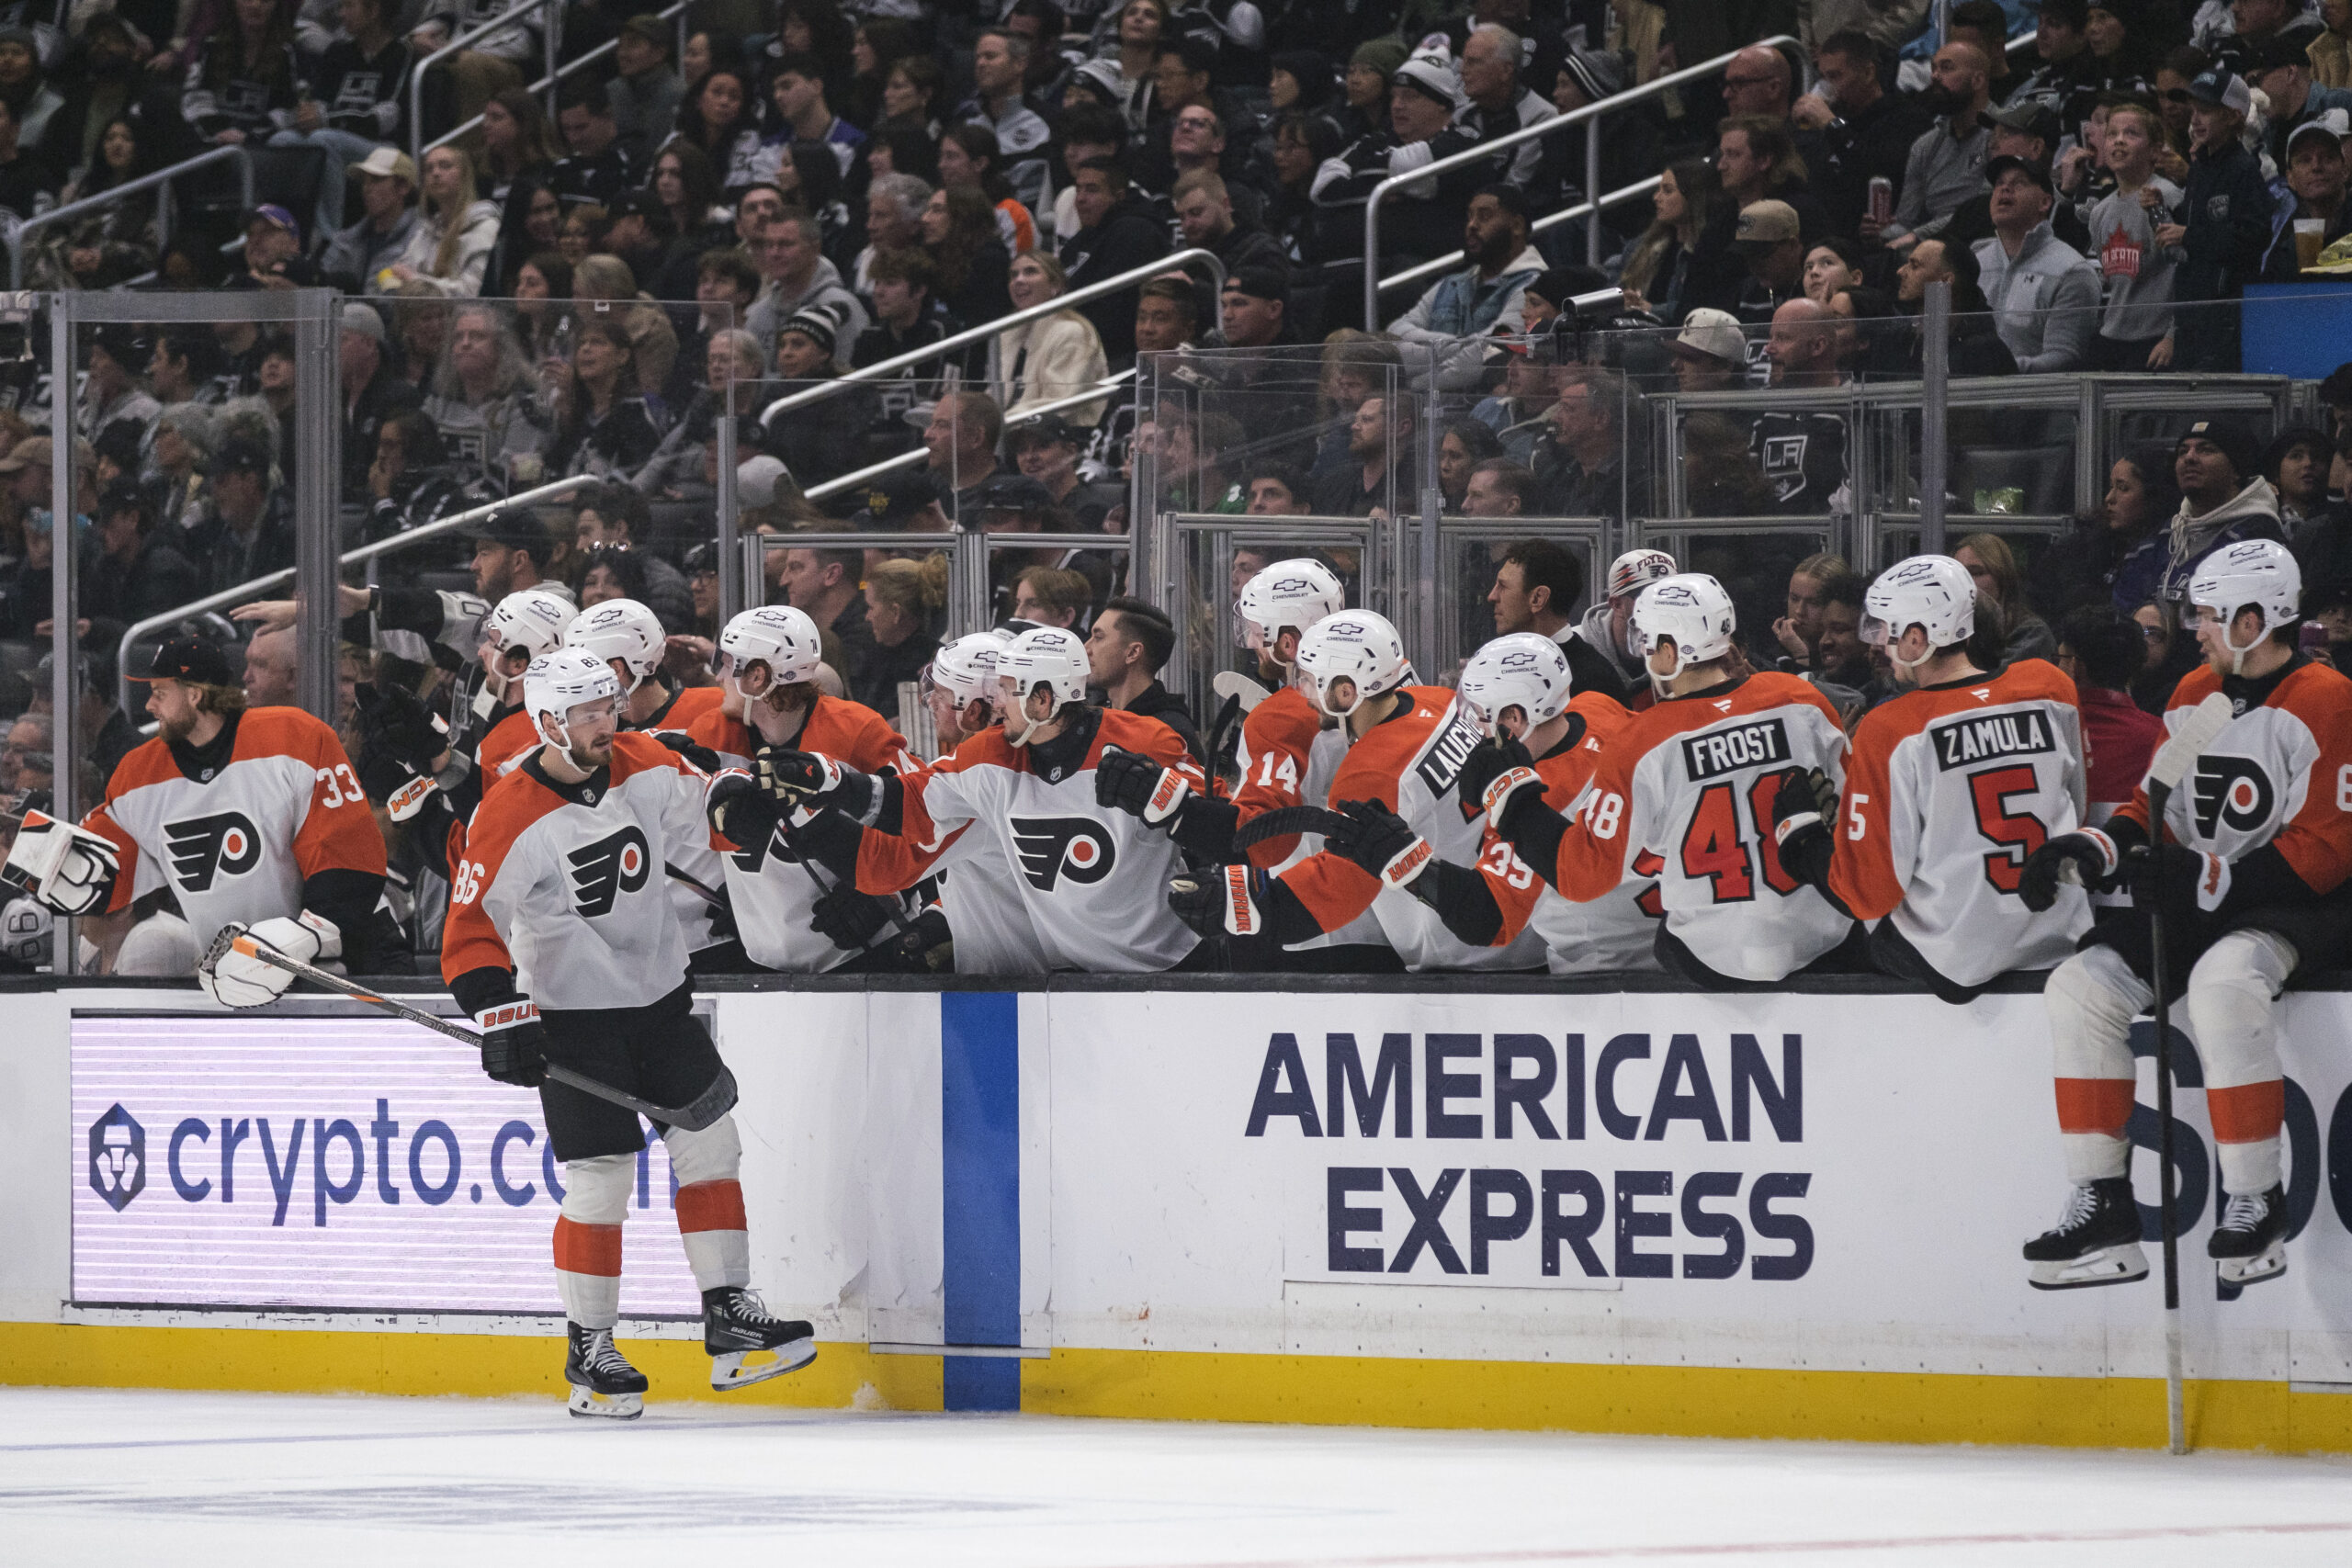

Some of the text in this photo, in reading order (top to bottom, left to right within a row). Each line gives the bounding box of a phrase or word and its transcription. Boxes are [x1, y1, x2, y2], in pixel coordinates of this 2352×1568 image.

[1766, 442, 1803, 468] LA
[592, 620, 626, 632] CHEVROLET
[752, 620, 785, 630] CHEVROLET
[1501, 667, 1539, 675] CHEVROLET
[1691, 724, 1776, 775] FROST
[1943, 714, 2047, 764] ZAMULA
[316, 763, 364, 809] 33
[1151, 769, 1182, 812] RIOR
[1257, 751, 1297, 795] 14
[1848, 793, 1869, 840] 5
[1967, 763, 2049, 895] 5
[452, 859, 486, 906] 86
[1387, 839, 1433, 883] RIOR
[483, 1002, 540, 1028] BAUE
[1244, 1032, 1804, 1143] AMERICAN
[1327, 1167, 1815, 1281] EXPRESS
[730, 1326, 763, 1339] BAUER
